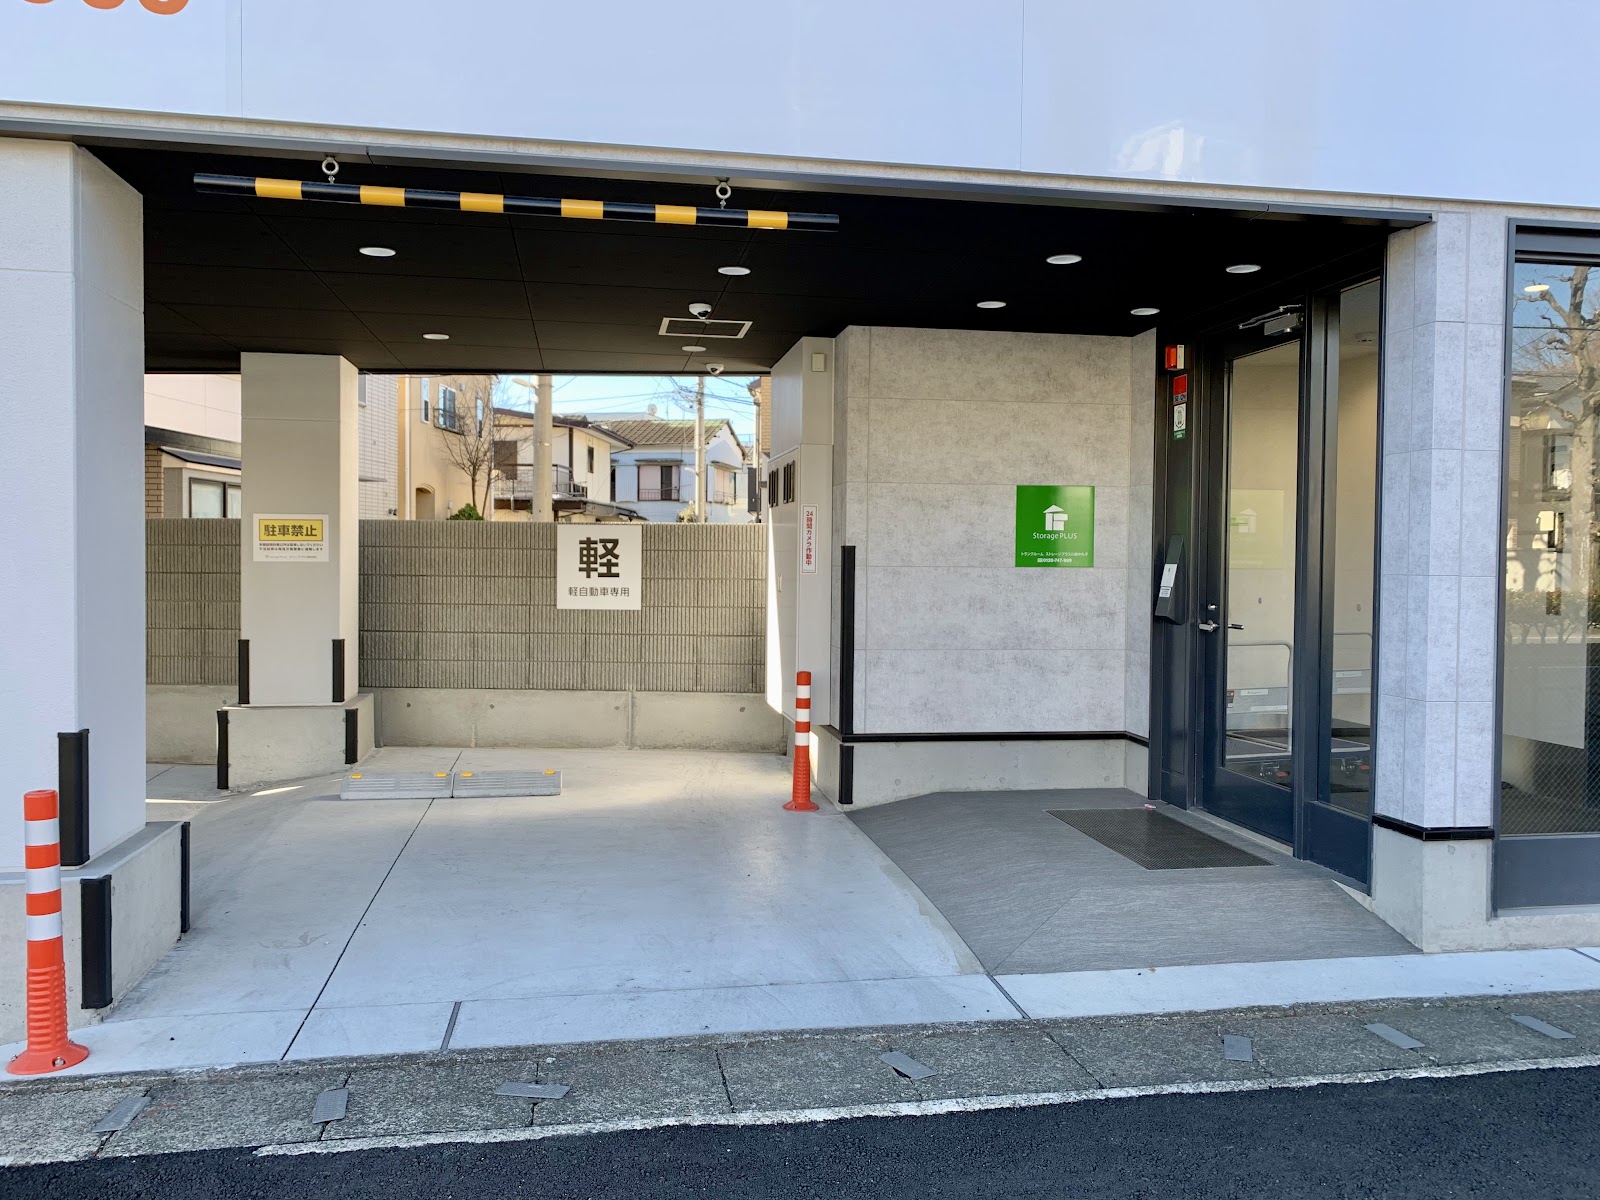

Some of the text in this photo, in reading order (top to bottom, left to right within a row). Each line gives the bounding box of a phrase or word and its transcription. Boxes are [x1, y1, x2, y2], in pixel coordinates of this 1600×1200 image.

[264, 525, 317, 537] 駐車禁止
[1033, 532, 1059, 540] Storage
[805, 511, 813, 566] 24時間カメラ作動中
[578, 536, 620, 579] 軽
[568, 586, 630, 597] 軽自動車専用
